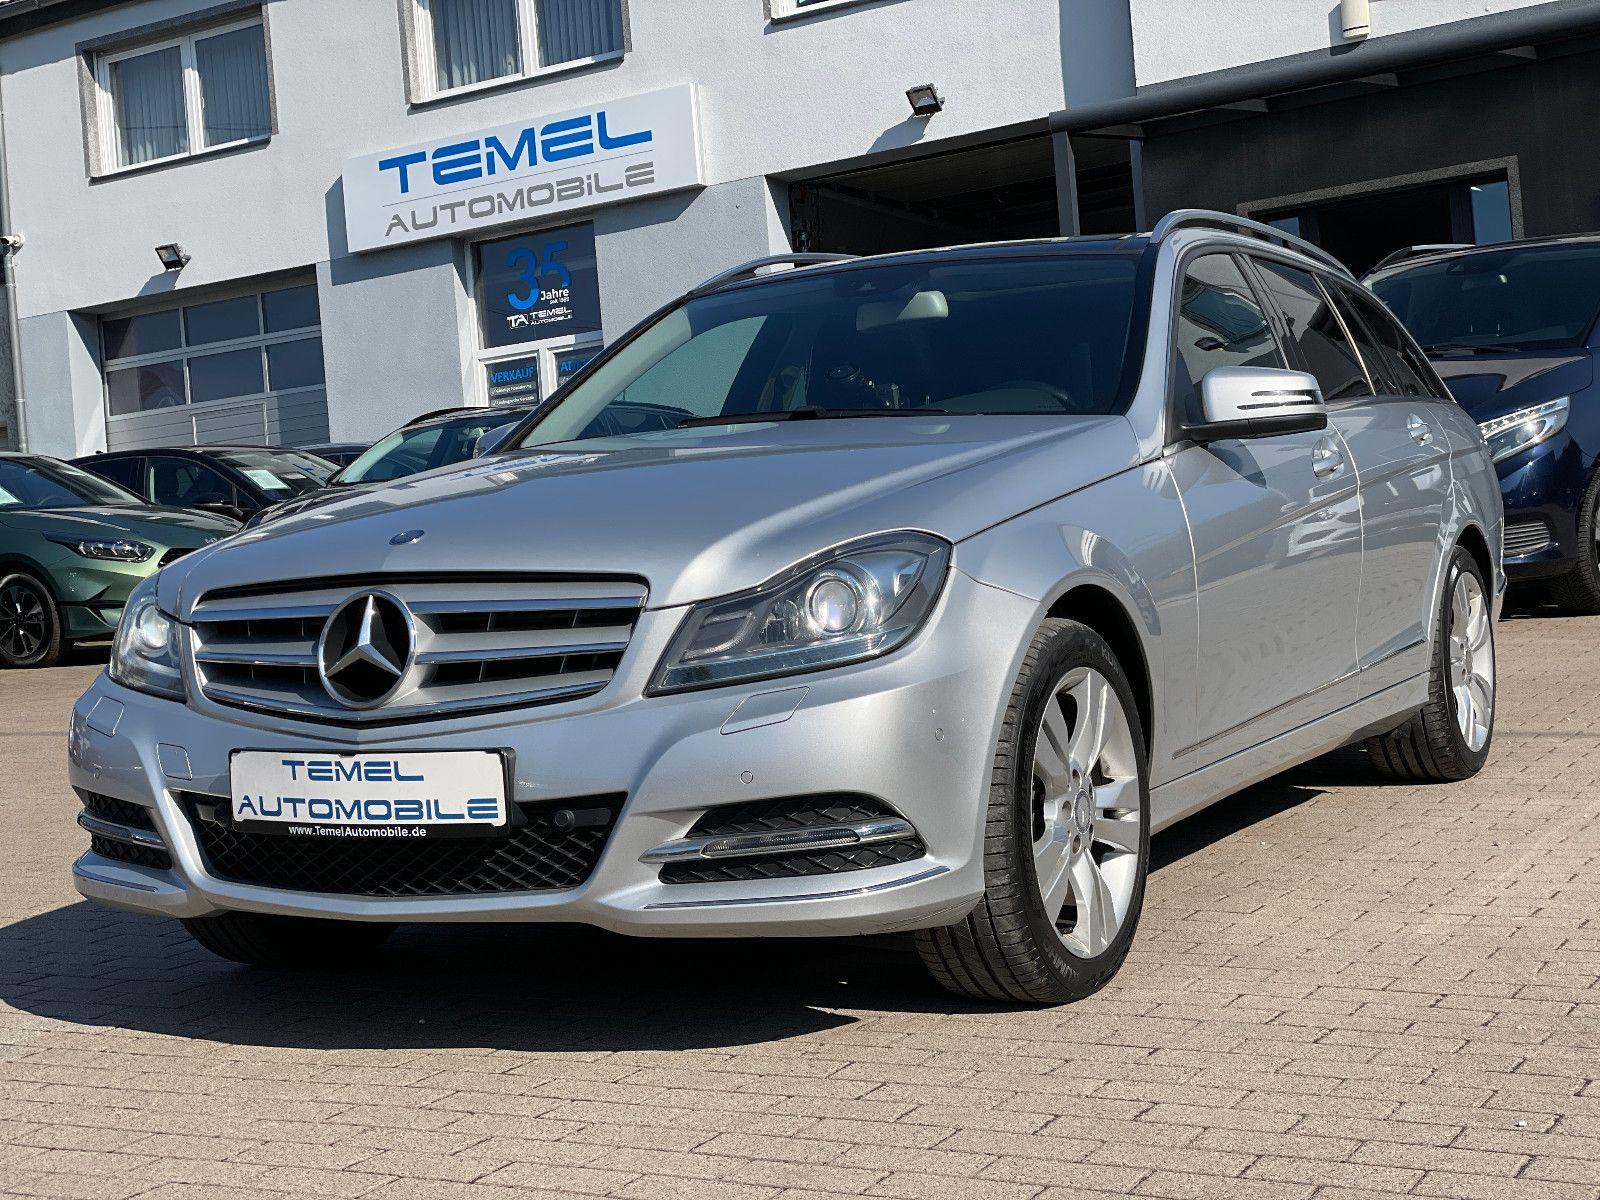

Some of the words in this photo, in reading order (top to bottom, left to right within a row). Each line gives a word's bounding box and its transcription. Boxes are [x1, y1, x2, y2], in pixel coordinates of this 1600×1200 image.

[378, 110, 653, 194] TEMEL
[384, 160, 655, 237] AUTOMOBILE
[505, 240, 572, 310] 35
[541, 288, 569, 301] Jahre
[507, 313, 529, 328] TA
[530, 307, 572, 319] TEMEL
[530, 315, 573, 326] AUTOMOBILE
[490, 366, 534, 383] VERKAUF
[281, 759, 424, 782] TEMEL
[238, 795, 499, 820] AUTOMOBILE
[288, 825, 427, 837] www.TemelAutomobile.de
